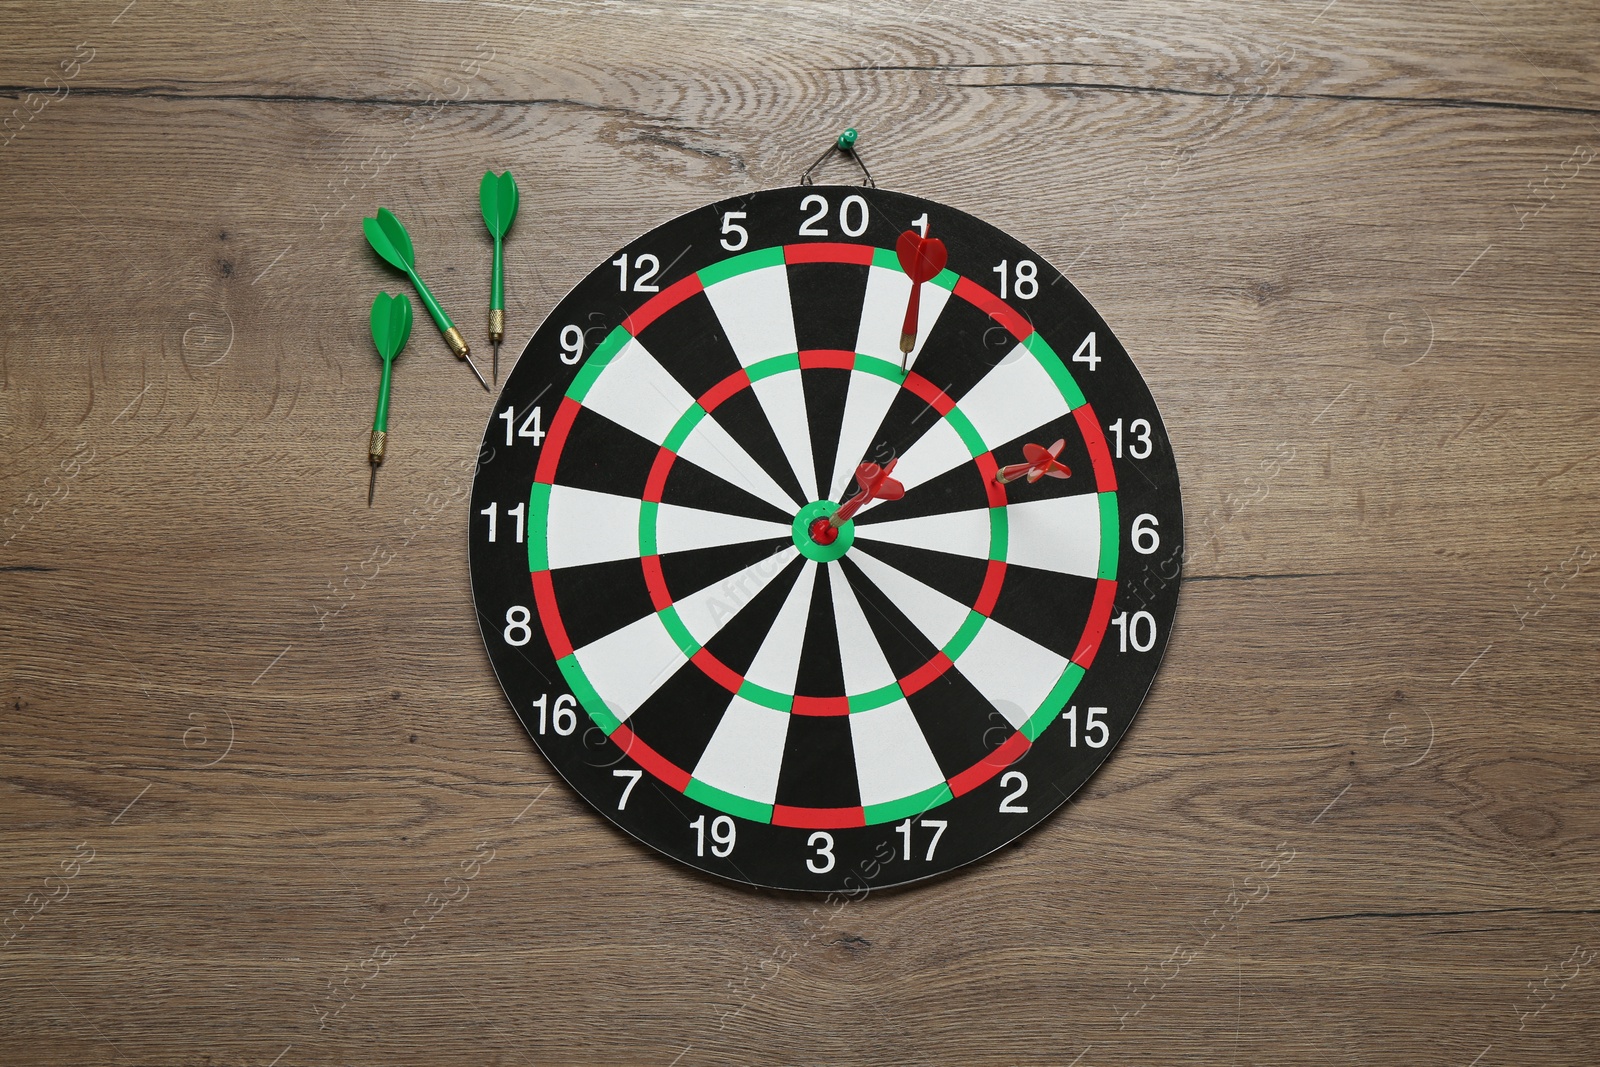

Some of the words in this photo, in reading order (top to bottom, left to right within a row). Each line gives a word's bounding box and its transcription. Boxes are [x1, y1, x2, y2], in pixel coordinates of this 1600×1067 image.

[720, 212, 748, 251] 5
[799, 195, 869, 237] 20
[912, 213, 928, 239] 1
[613, 254, 659, 292] 12
[993, 260, 1038, 299] 18
[560, 325, 584, 365] 9
[1073, 332, 1101, 371] 4
[499, 406, 545, 446] 14
[1109, 418, 1152, 459] 13
[481, 502, 524, 542] 11
[1132, 514, 1159, 554] 6
[504, 606, 531, 646] 8
[1112, 611, 1156, 652] 10
[533, 694, 576, 735] 16
[1063, 706, 1109, 748] 15
[613, 770, 642, 810] 7
[999, 771, 1028, 813] 2
[690, 815, 736, 857] 19
[807, 832, 835, 873] 3
[896, 819, 947, 861] 17
